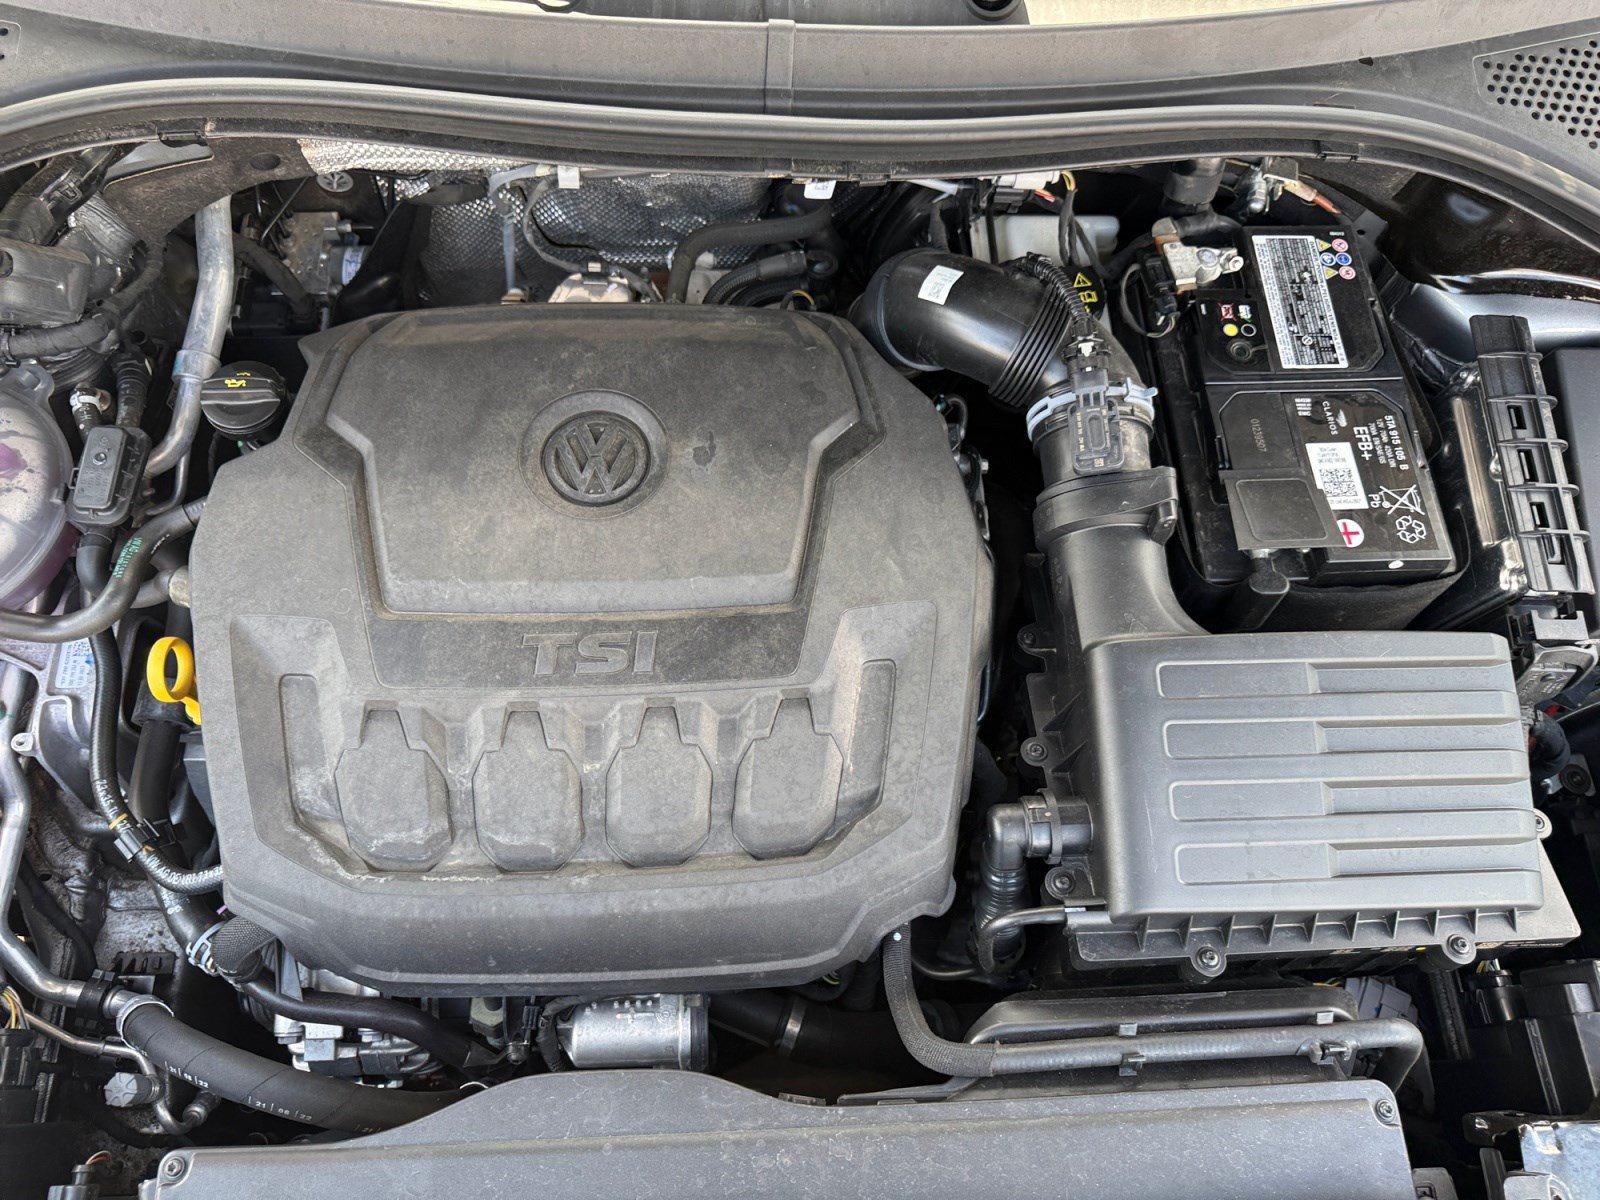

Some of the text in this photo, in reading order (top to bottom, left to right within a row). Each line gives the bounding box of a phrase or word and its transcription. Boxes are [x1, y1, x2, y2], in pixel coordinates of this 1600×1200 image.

[1322, 400, 1338, 435] CLARIOS
[1384, 415, 1396, 429] 5TA
[1353, 426, 1373, 461] EFB+
[1388, 430, 1401, 445] 915
[1394, 446, 1406, 461] 105
[1367, 493, 1381, 508] Pb
[522, 631, 657, 677] TSI
[198, 1080, 208, 1088] 22
